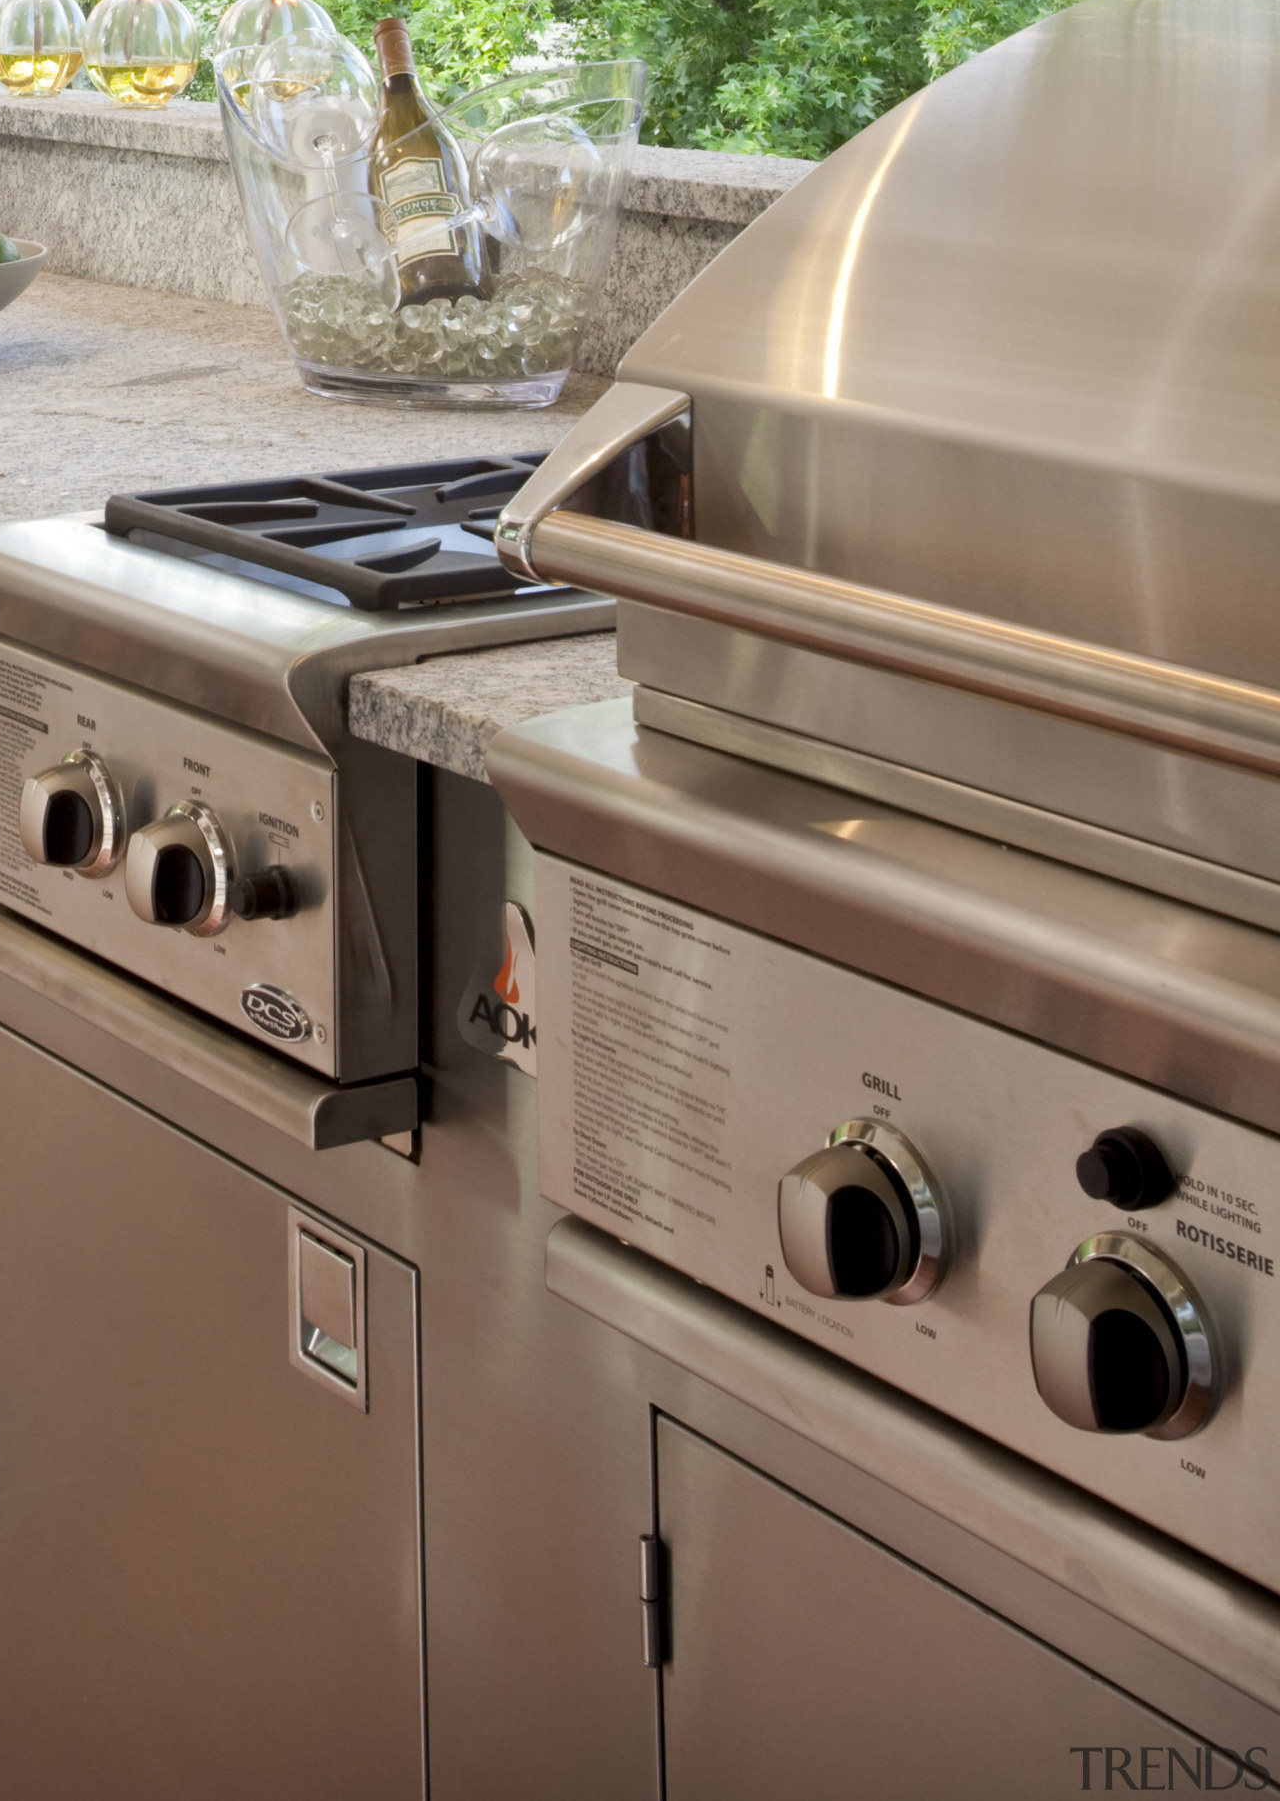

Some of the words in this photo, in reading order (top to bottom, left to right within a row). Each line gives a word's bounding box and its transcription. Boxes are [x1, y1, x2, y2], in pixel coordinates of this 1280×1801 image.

[395, 199, 438, 216] KUNDE
[77, 714, 96, 731] REAR
[183, 757, 211, 778] FRONT
[259, 811, 299, 838] IGNITION
[246, 994, 296, 1028] DCS
[862, 1072, 901, 1101] GRILL
[873, 1104, 891, 1119] OFF
[1175, 1171, 1204, 1192] HOLD
[1207, 1185, 1218, 1198] IN
[1221, 1191, 1233, 1204] 10
[1235, 1197, 1258, 1215] SEC.
[1176, 1189, 1208, 1212] WHILE
[1210, 1203, 1261, 1234] LIGHTING
[1127, 1217, 1148, 1233] OFF
[1176, 1219, 1274, 1276] ROTISSERIE
[784, 1296, 816, 1319] BATTERY
[817, 1313, 854, 1339] LOCATION
[915, 1321, 937, 1340] LOW
[1181, 1458, 1206, 1479] LOW
